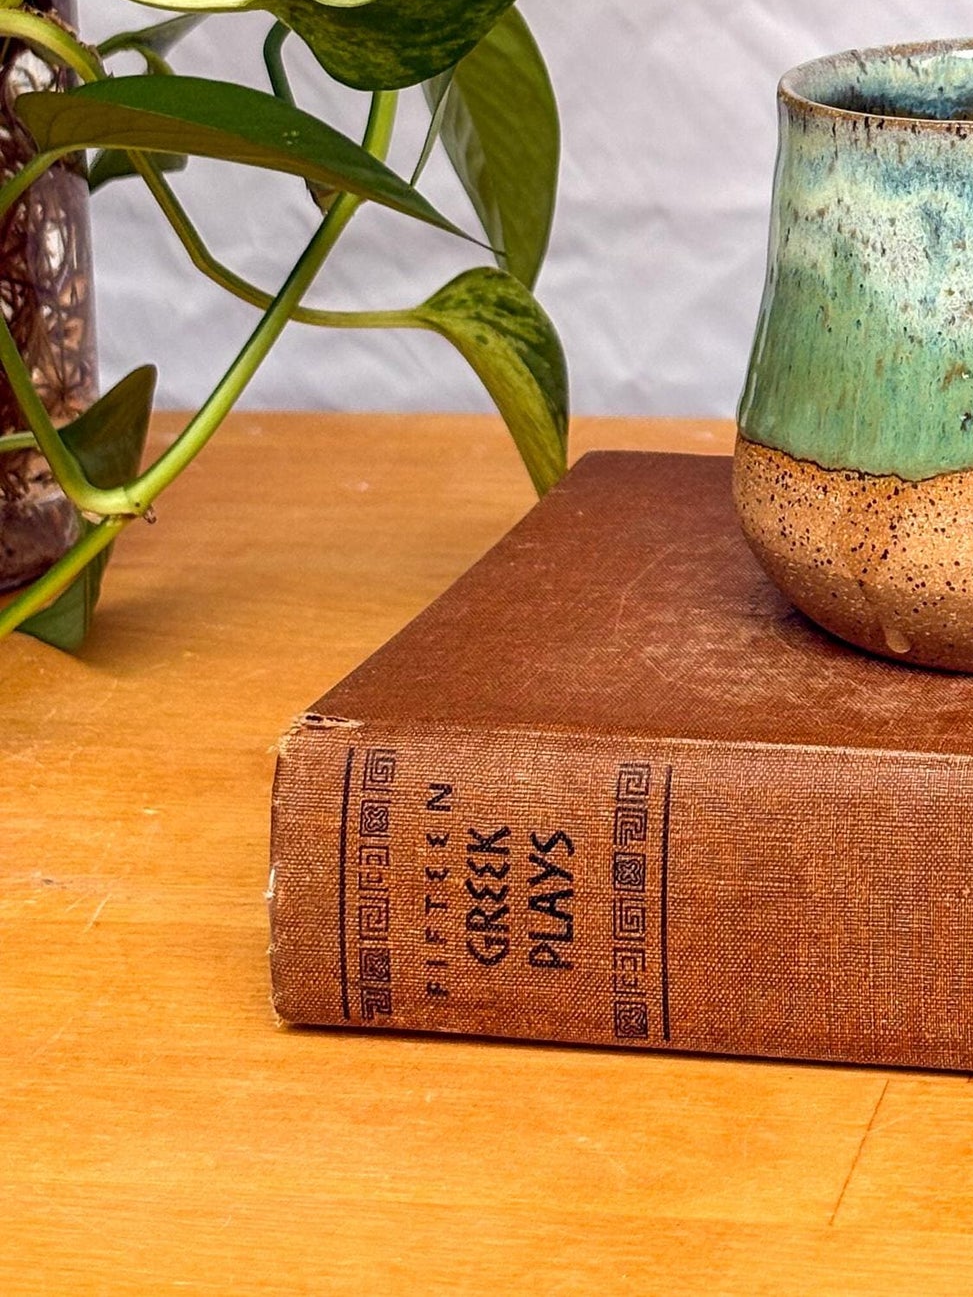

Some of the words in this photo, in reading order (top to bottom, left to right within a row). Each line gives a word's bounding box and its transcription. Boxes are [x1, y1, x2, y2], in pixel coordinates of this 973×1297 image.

[425, 783, 453, 997] FIFTEEN
[465, 826, 511, 966] GREEK
[527, 830, 575, 969] PLAYS
